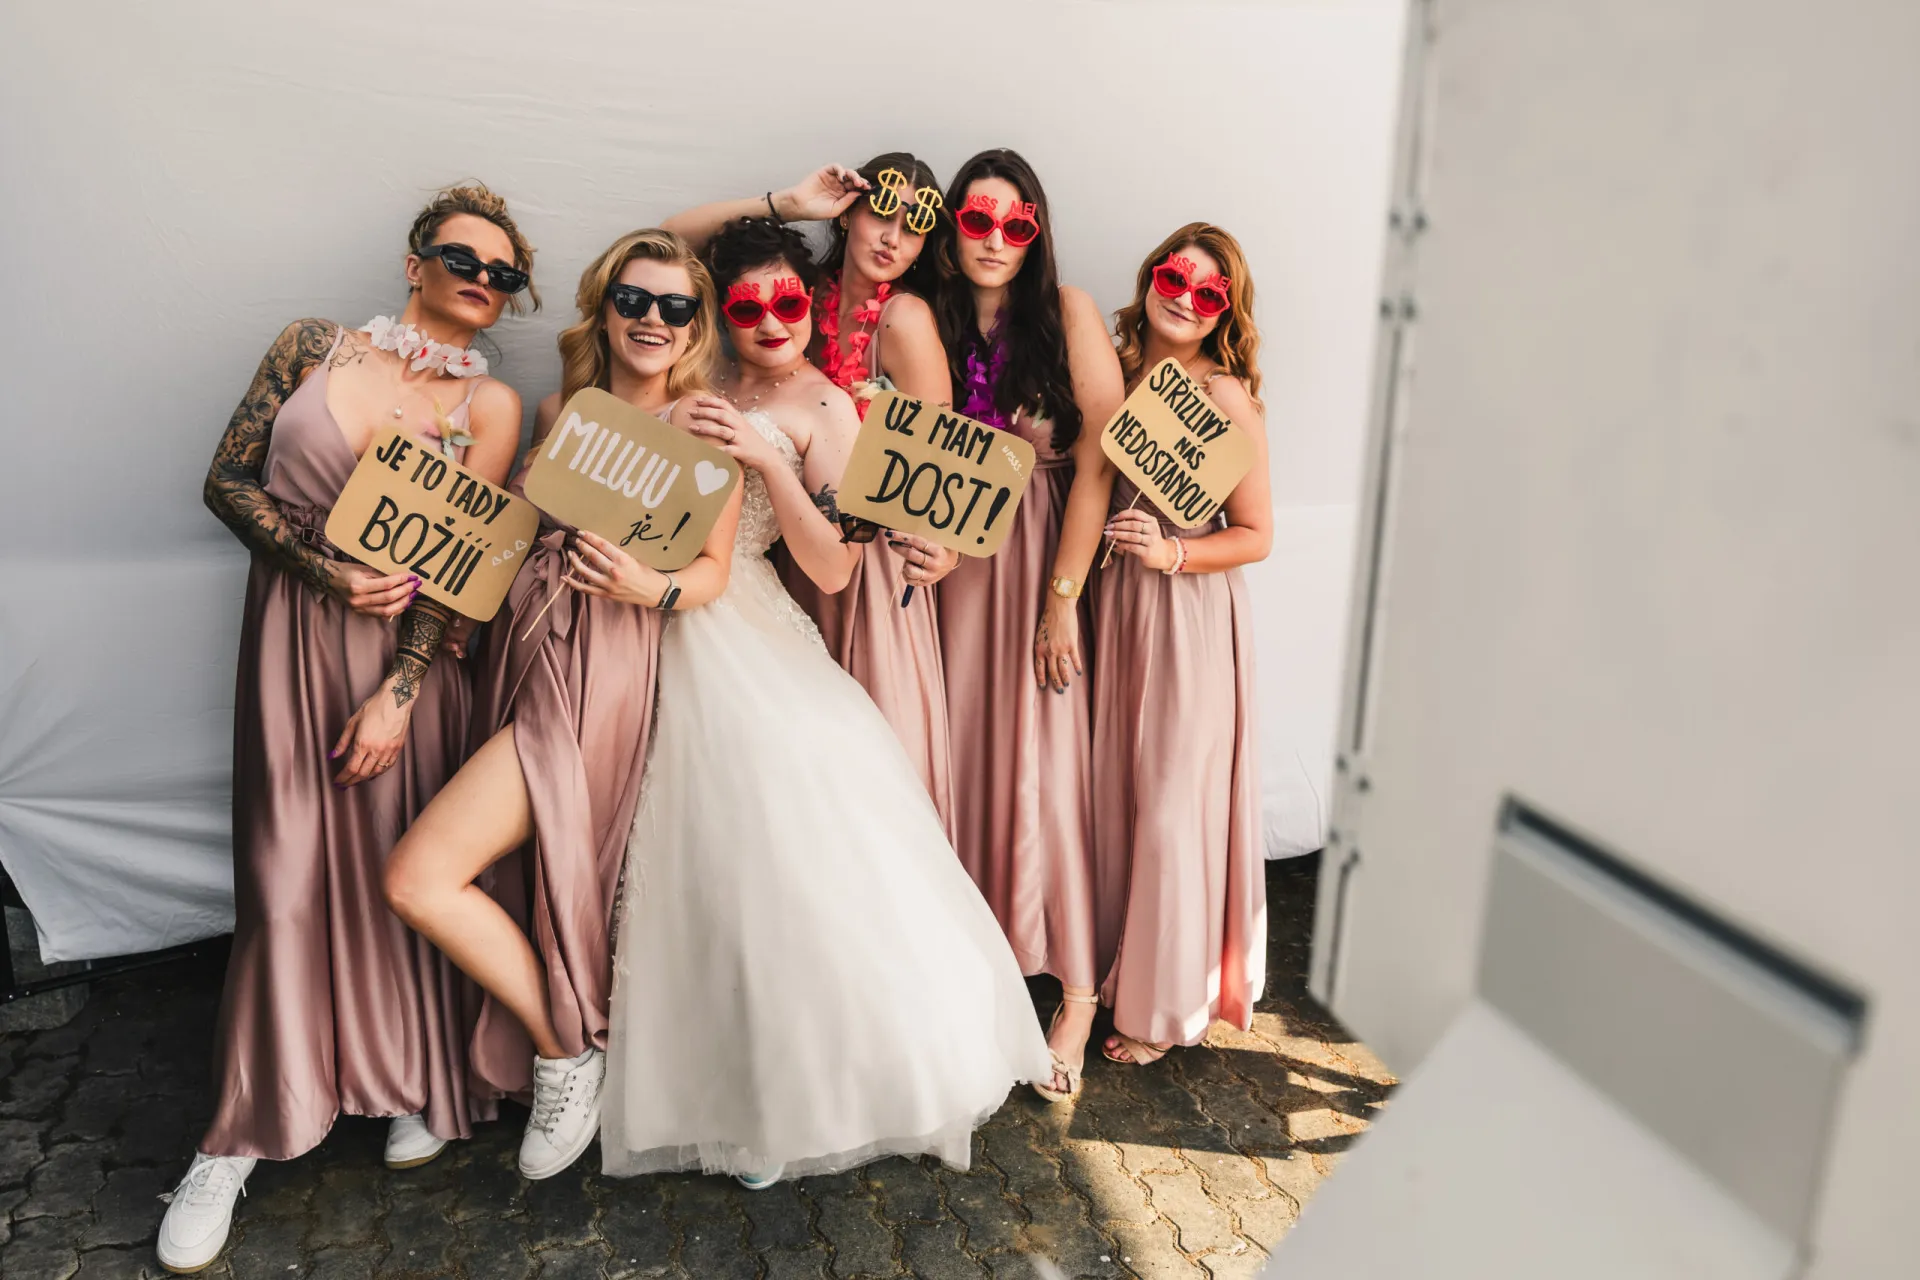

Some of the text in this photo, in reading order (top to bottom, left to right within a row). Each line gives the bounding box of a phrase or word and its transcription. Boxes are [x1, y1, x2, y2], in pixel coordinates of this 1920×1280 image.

[967, 194, 1037, 216] KISS ME!
[727, 282, 761, 297] KISS
[1167, 251, 1198, 274] KISS
[884, 396, 995, 465] UŽ MÁM
[1149, 362, 1231, 443] STŘÍZLIVÝ
[376, 434, 511, 525] JE TO TADY
[547, 411, 682, 508] MILUJU
[1108, 409, 1218, 527] NEDOSTANOU!
[1173, 435, 1206, 470] NÁS
[865, 448, 1011, 545] DOST!
[358, 495, 492, 596] BOŽÍÍÍ
